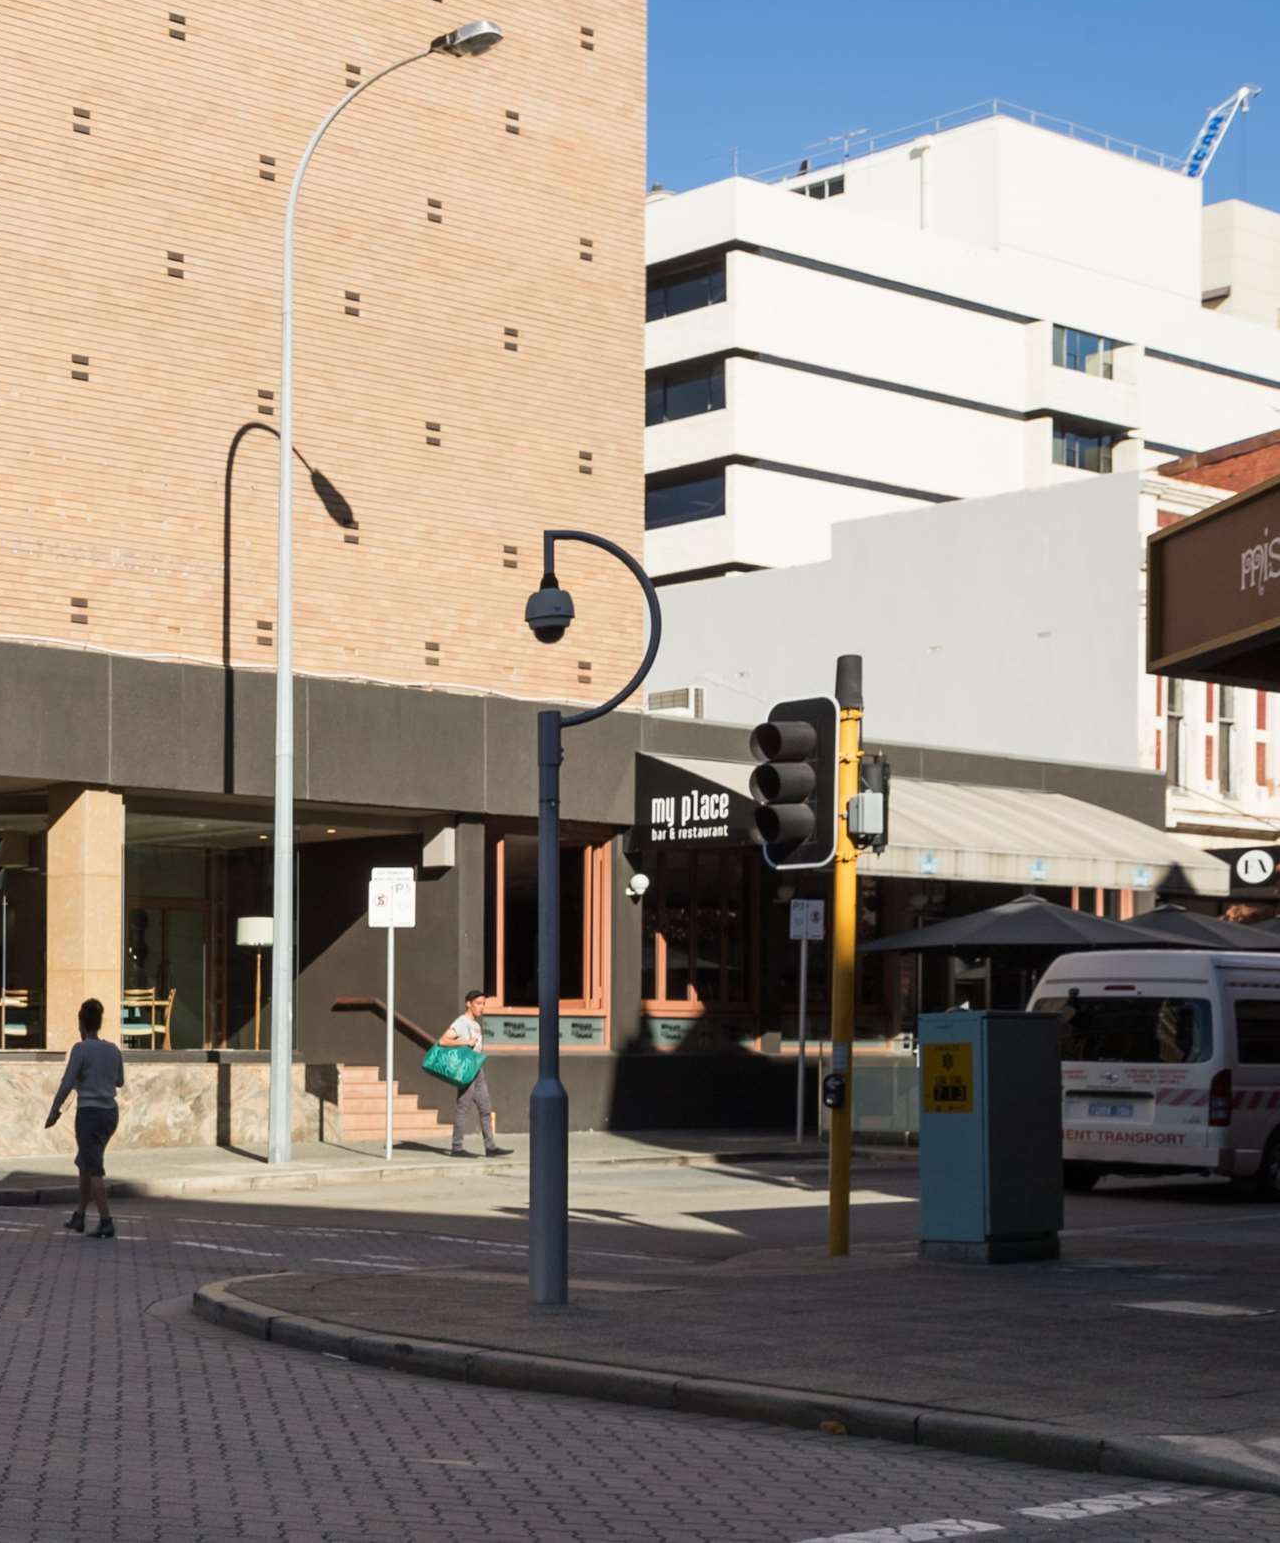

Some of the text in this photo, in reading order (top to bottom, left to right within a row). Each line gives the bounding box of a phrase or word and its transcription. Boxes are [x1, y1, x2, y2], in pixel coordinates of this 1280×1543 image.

[651, 789, 729, 827] my place
[651, 825, 728, 841] bar & restaurant
[1097, 1130, 1186, 1145] TRANSPORT
